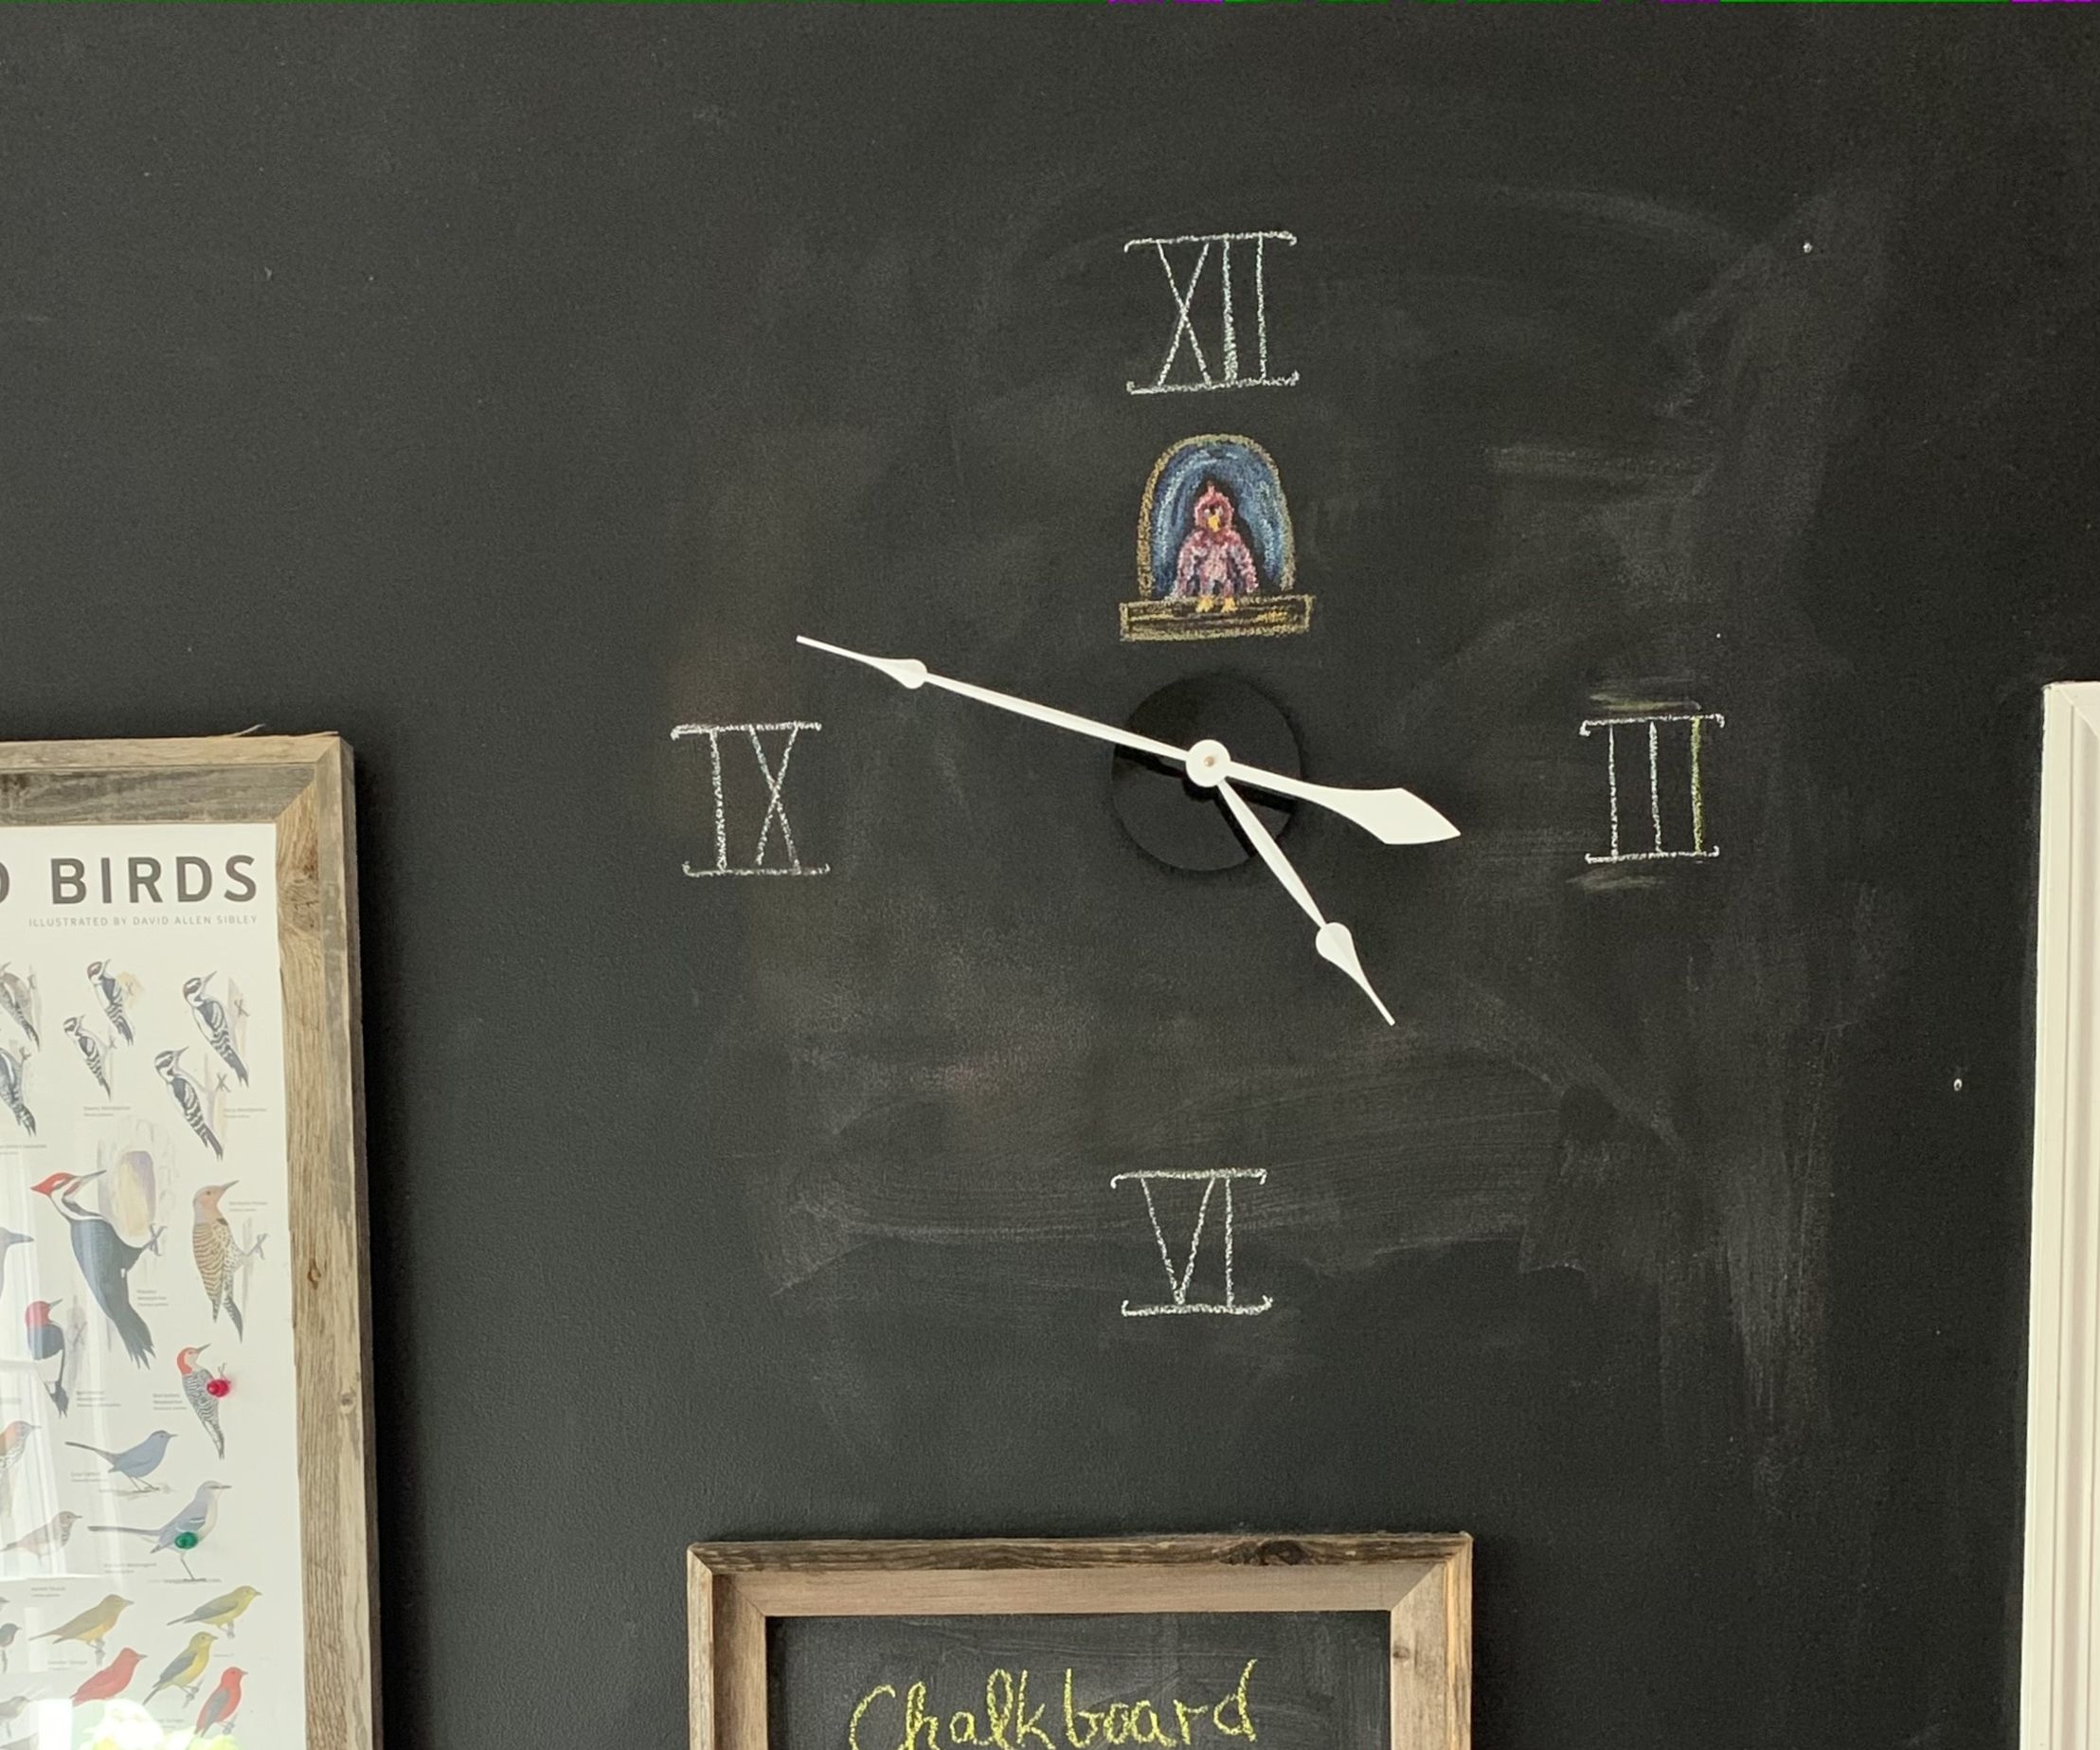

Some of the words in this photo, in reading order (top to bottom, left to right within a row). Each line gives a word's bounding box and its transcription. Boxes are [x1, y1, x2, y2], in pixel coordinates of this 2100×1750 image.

[1124, 231, 1300, 394] XII
[670, 720, 831, 878] IX
[1579, 713, 1725, 864] III
[28, 916, 108, 928] ILLUSTRATED
[113, 916, 128, 927] BY
[133, 915, 169, 926] DAVID
[174, 915, 211, 925] ALLEN
[216, 914, 258, 925] SIBLEY
[50, 855, 258, 905] BIRDS
[1110, 1167, 1273, 1317] VI
